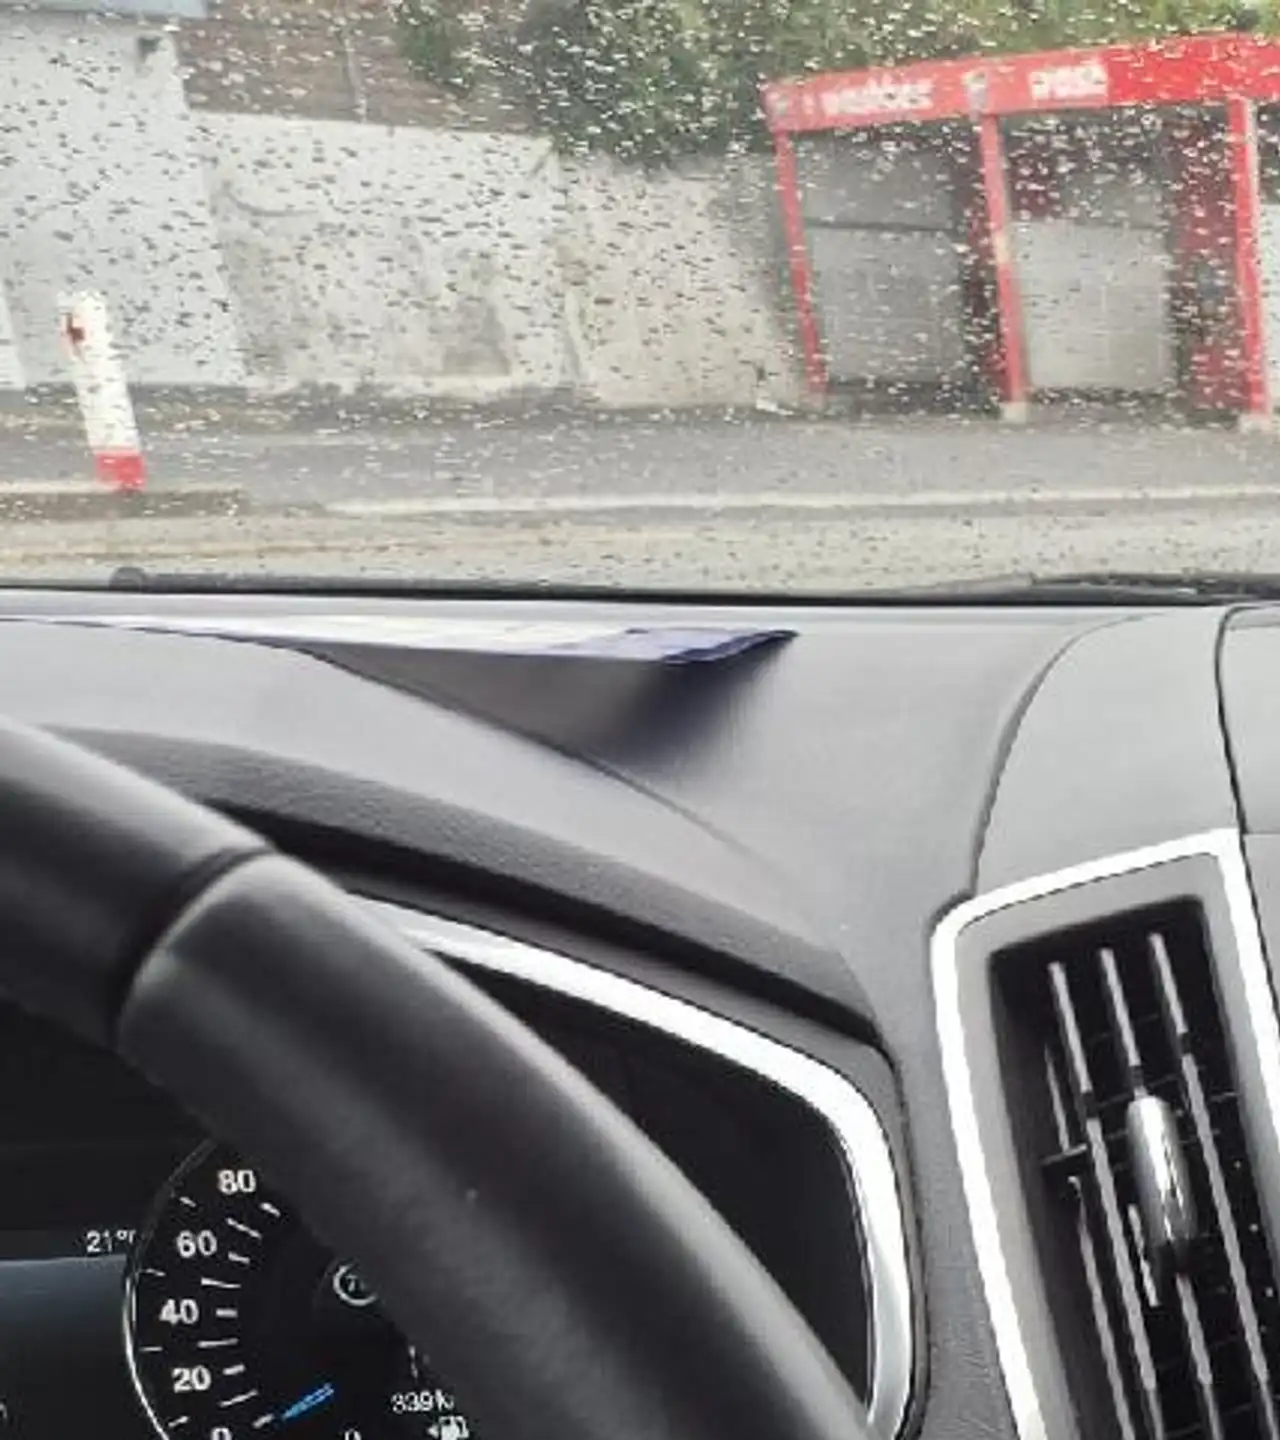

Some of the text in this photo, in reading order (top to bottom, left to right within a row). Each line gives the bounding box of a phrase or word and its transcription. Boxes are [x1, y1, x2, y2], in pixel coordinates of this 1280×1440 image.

[217, 1169, 256, 1194] 80
[176, 1229, 218, 1258] 60
[159, 1299, 199, 1325] 40
[172, 1365, 212, 1394] 20
